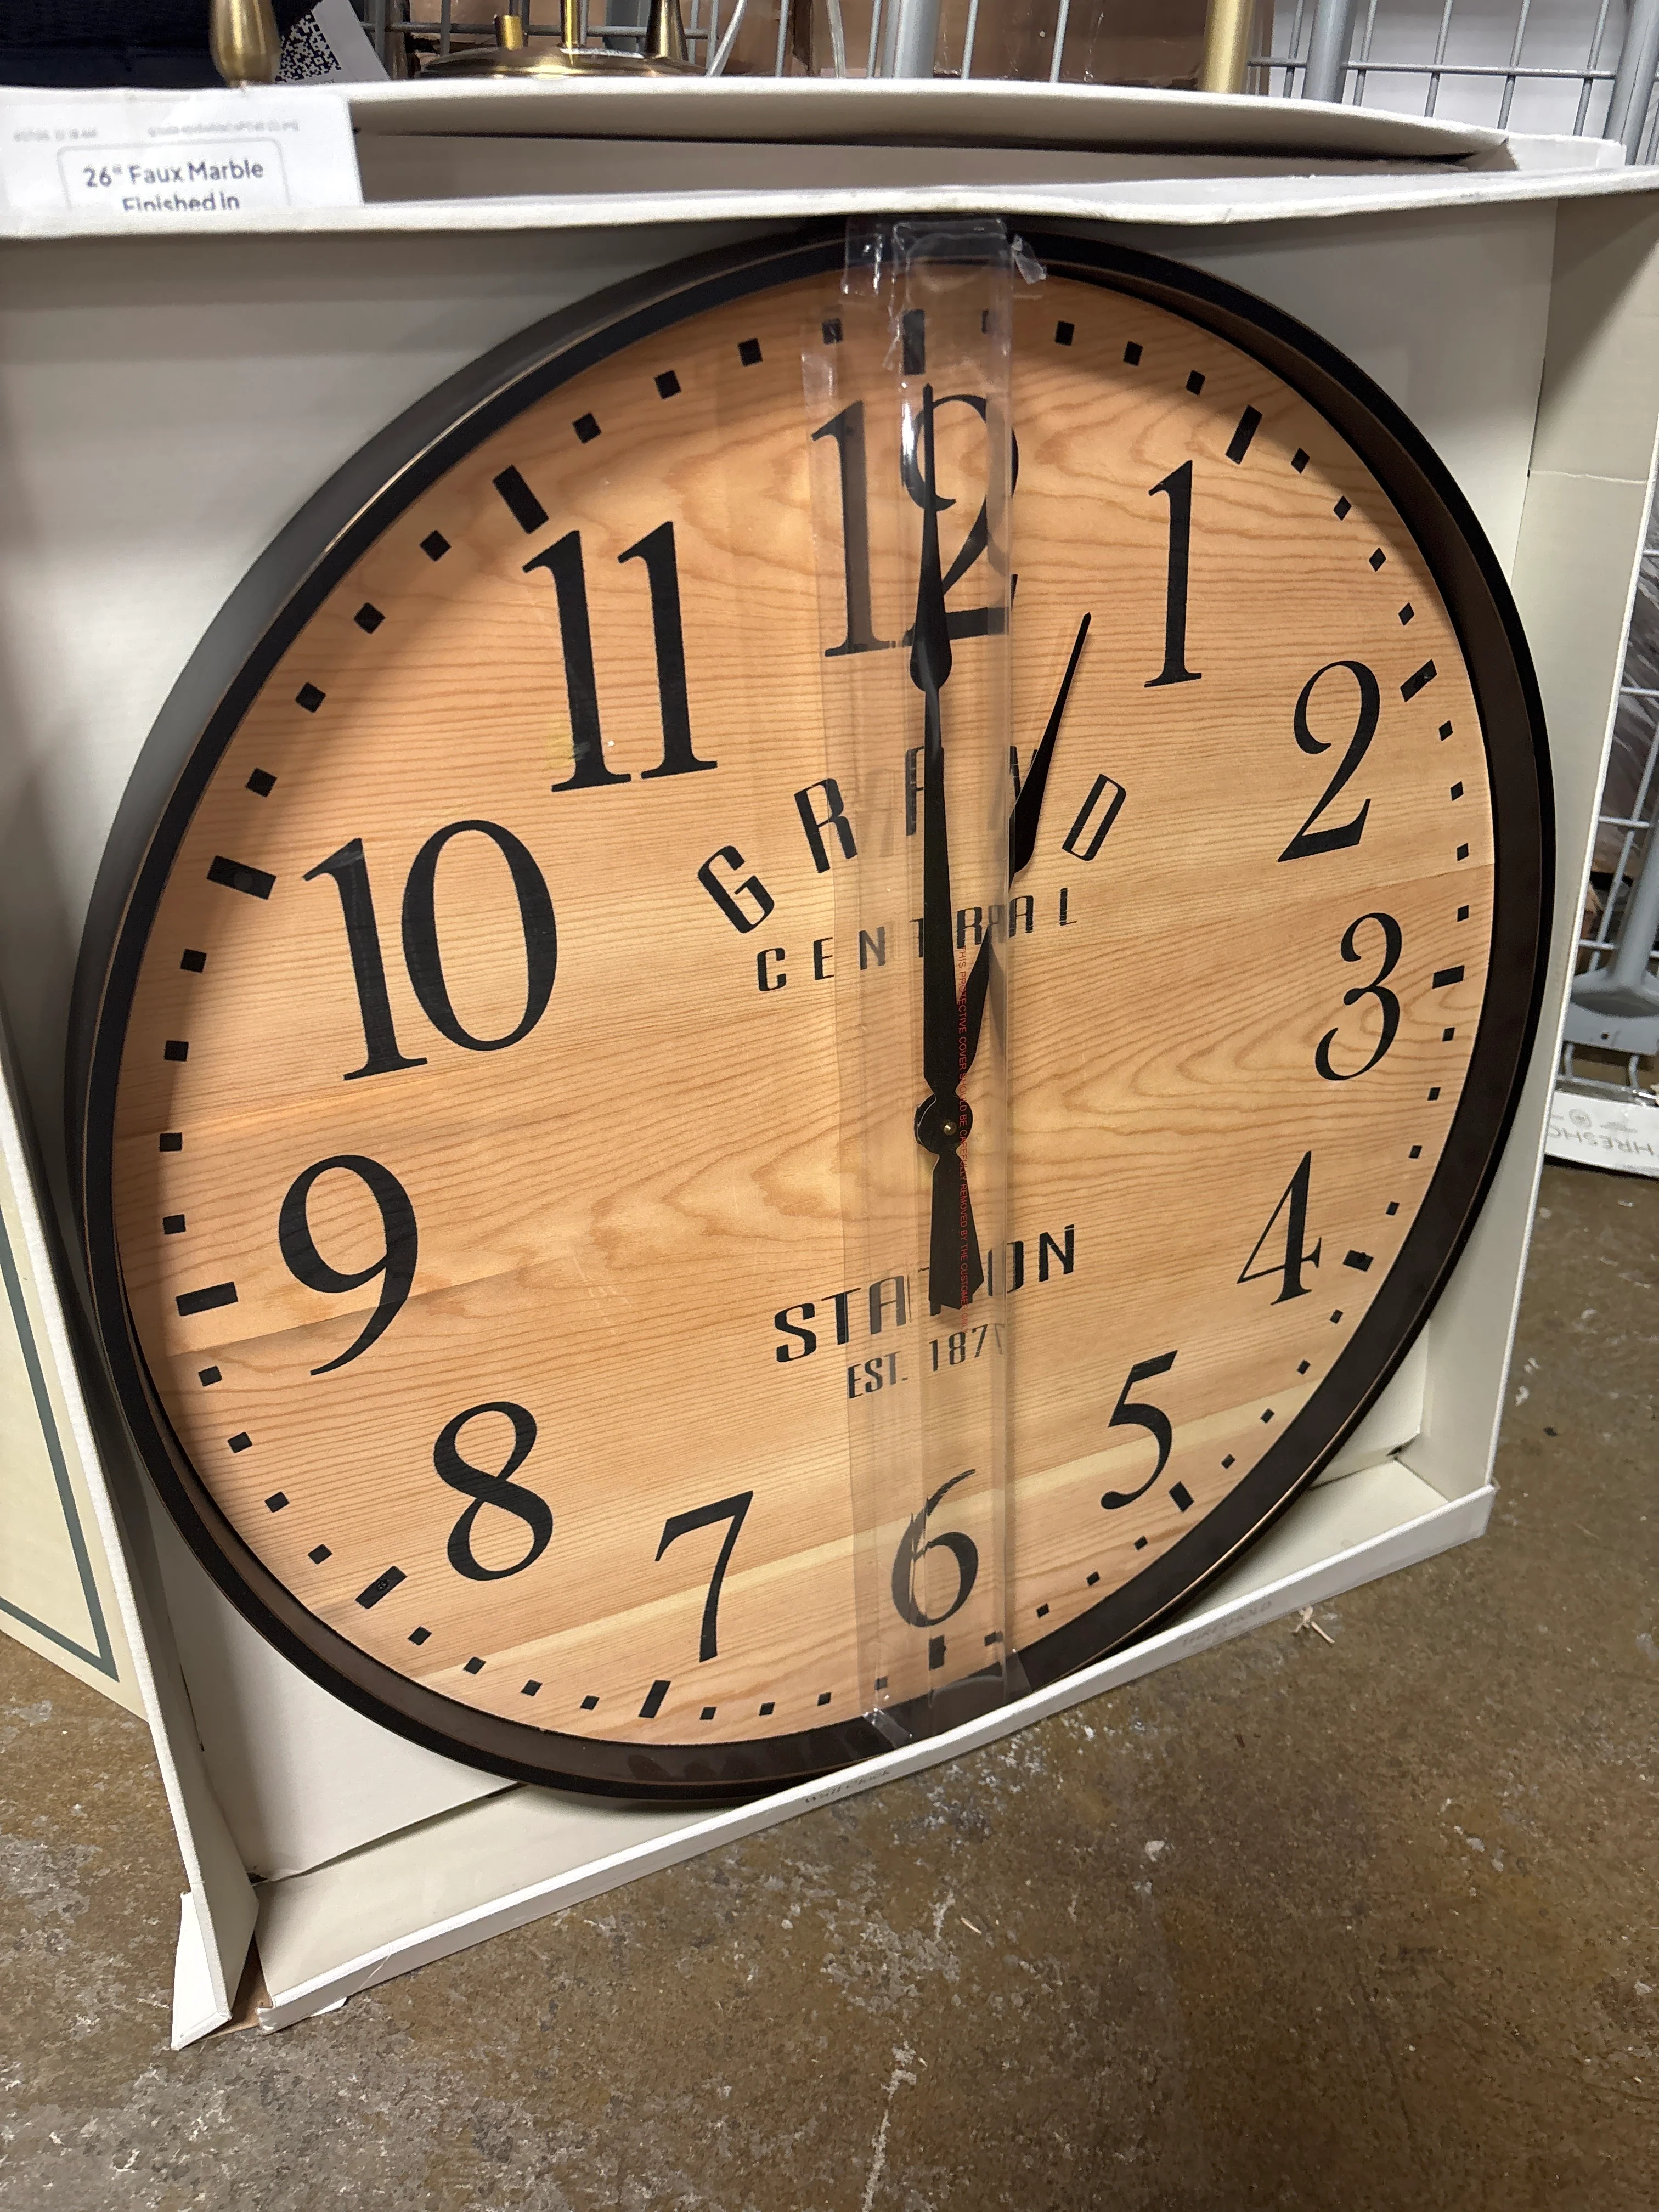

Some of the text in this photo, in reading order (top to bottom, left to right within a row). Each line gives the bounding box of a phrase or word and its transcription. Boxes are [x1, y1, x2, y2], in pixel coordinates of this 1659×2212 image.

[122, 190, 241, 211] Finished In
[128, 165, 185, 185] Faux
[187, 159, 264, 182] Marble
[811, 394, 1019, 657] 12
[1144, 460, 1202, 688] 1
[522, 521, 718, 792] 11
[1278, 660, 1380, 863] 2
[302, 820, 557, 1081] 10
[1316, 912, 1402, 1081] 3
[958, 1037, 967, 1070] COVER
[959, 1115, 968, 1127] BE
[278, 1154, 418, 1376] 9
[960, 1183, 968, 1227] REMOVED
[960, 1231, 968, 1241] BY
[960, 1243, 969, 1261] THE
[1237, 1150, 1322, 1306] 4
[774, 1224, 1075, 1363] STAION
[848, 1323, 1005, 1399] EST. 187
[433, 1401, 553, 1581] 8
[1101, 1350, 1178, 1510] 5
[655, 1490, 753, 1663] 7
[891, 1469, 979, 1628] 6
